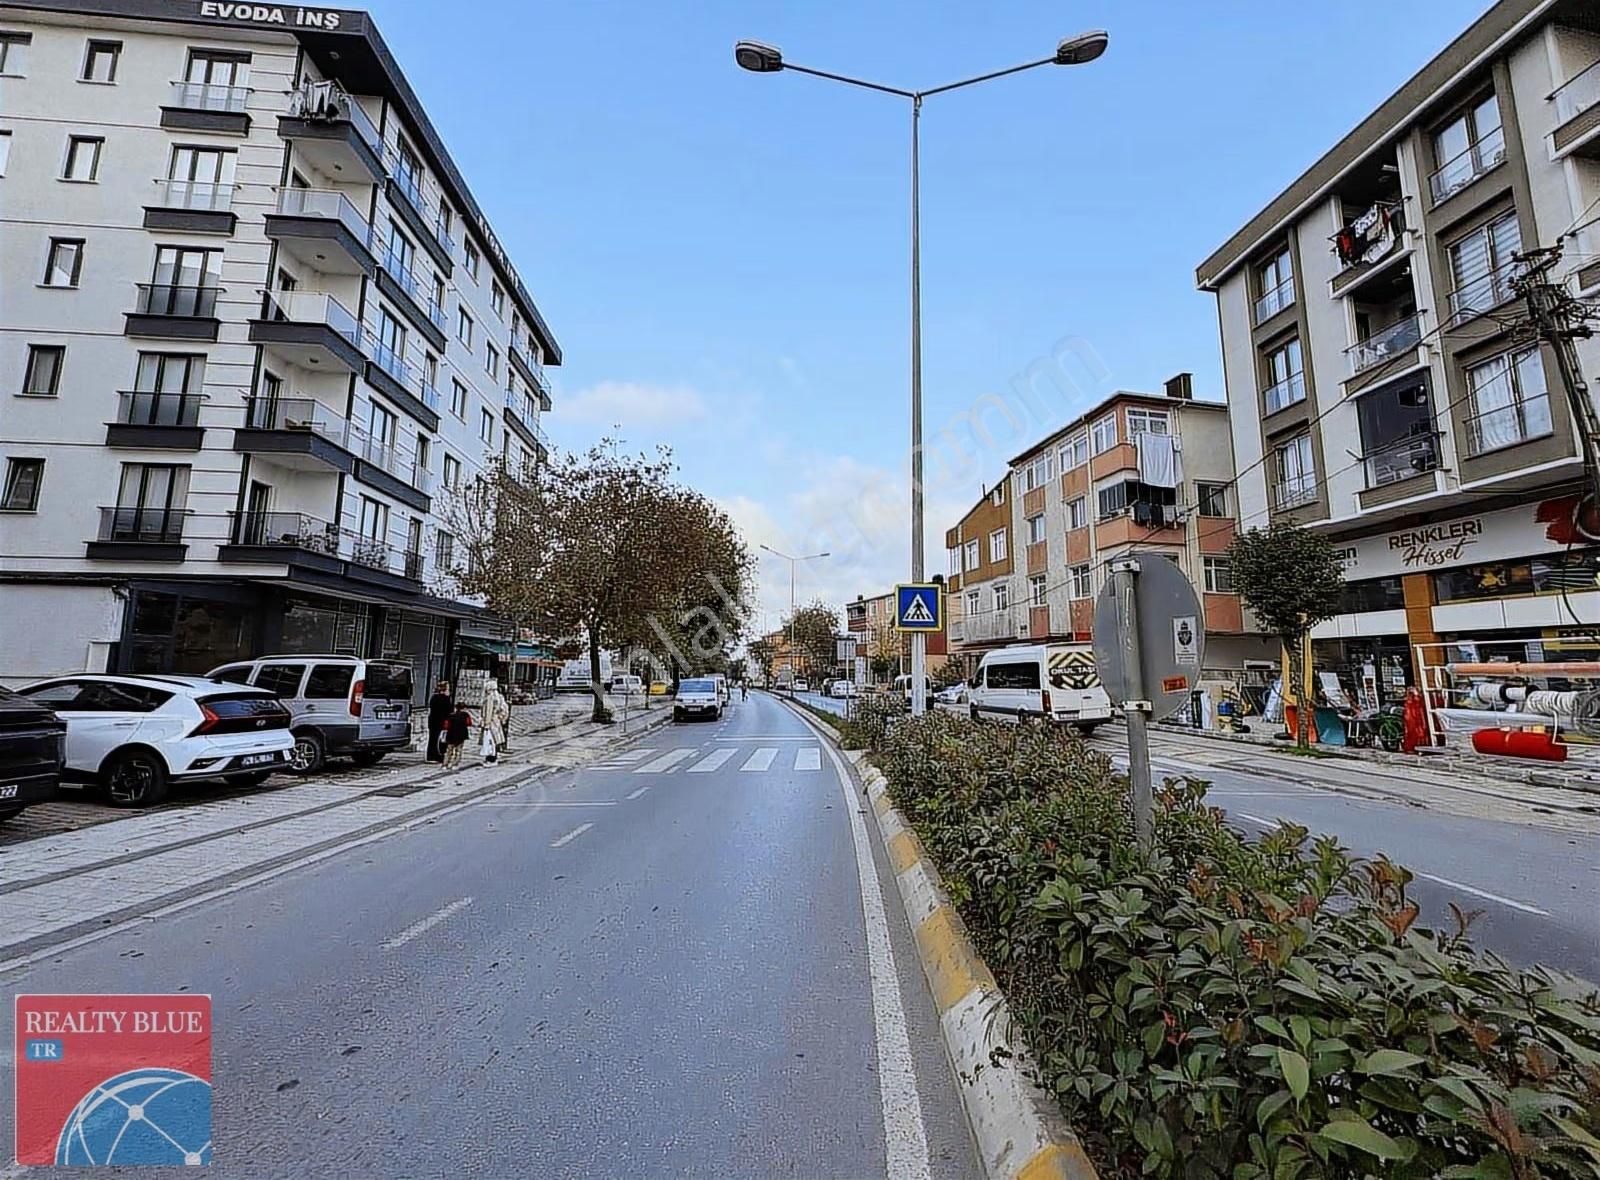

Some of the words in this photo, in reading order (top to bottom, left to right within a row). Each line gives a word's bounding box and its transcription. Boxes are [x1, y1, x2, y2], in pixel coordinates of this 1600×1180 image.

[200, 1, 285, 23] EVODA
[296, 7, 340, 30] İNŞ
[1402, 537, 1478, 567] Hisset
